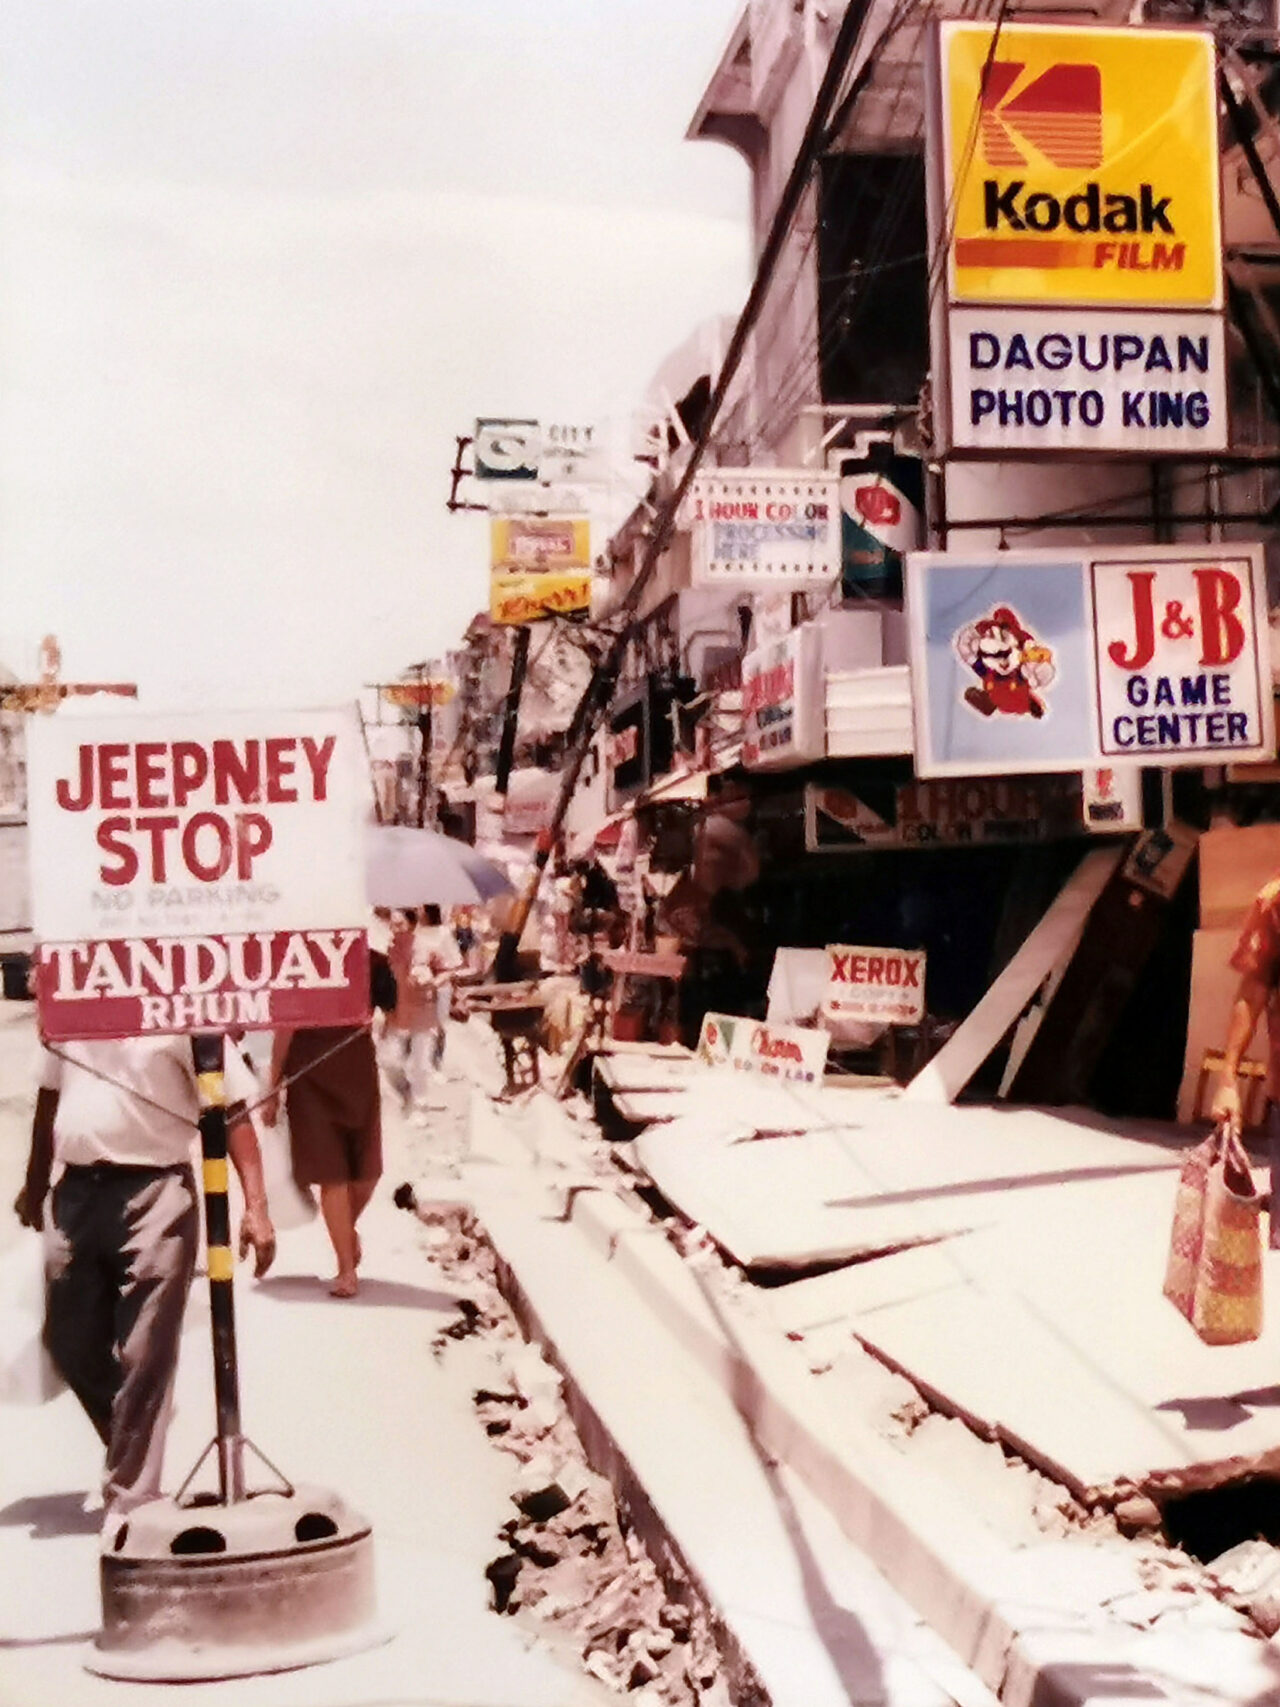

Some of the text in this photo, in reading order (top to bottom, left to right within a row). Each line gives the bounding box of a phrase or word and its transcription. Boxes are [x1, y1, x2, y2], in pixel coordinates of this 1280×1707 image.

[982, 180, 1176, 235] Kodak
[1092, 242, 1187, 271] FILM
[969, 332, 1210, 373] DAGUPAN
[970, 388, 1211, 428] PHOTO KING
[710, 502, 759, 520] HOUR
[1107, 567, 1246, 670] J&B
[1126, 672, 1232, 709] GAME
[1112, 711, 1249, 747] CENTER
[56, 735, 337, 812] JEEPNEY
[96, 811, 273, 886] STOP
[91, 883, 281, 911] NO PARKING
[42, 930, 363, 1000] TANDUAY
[830, 953, 921, 988] XEROX
[141, 990, 273, 1029] RHUM
